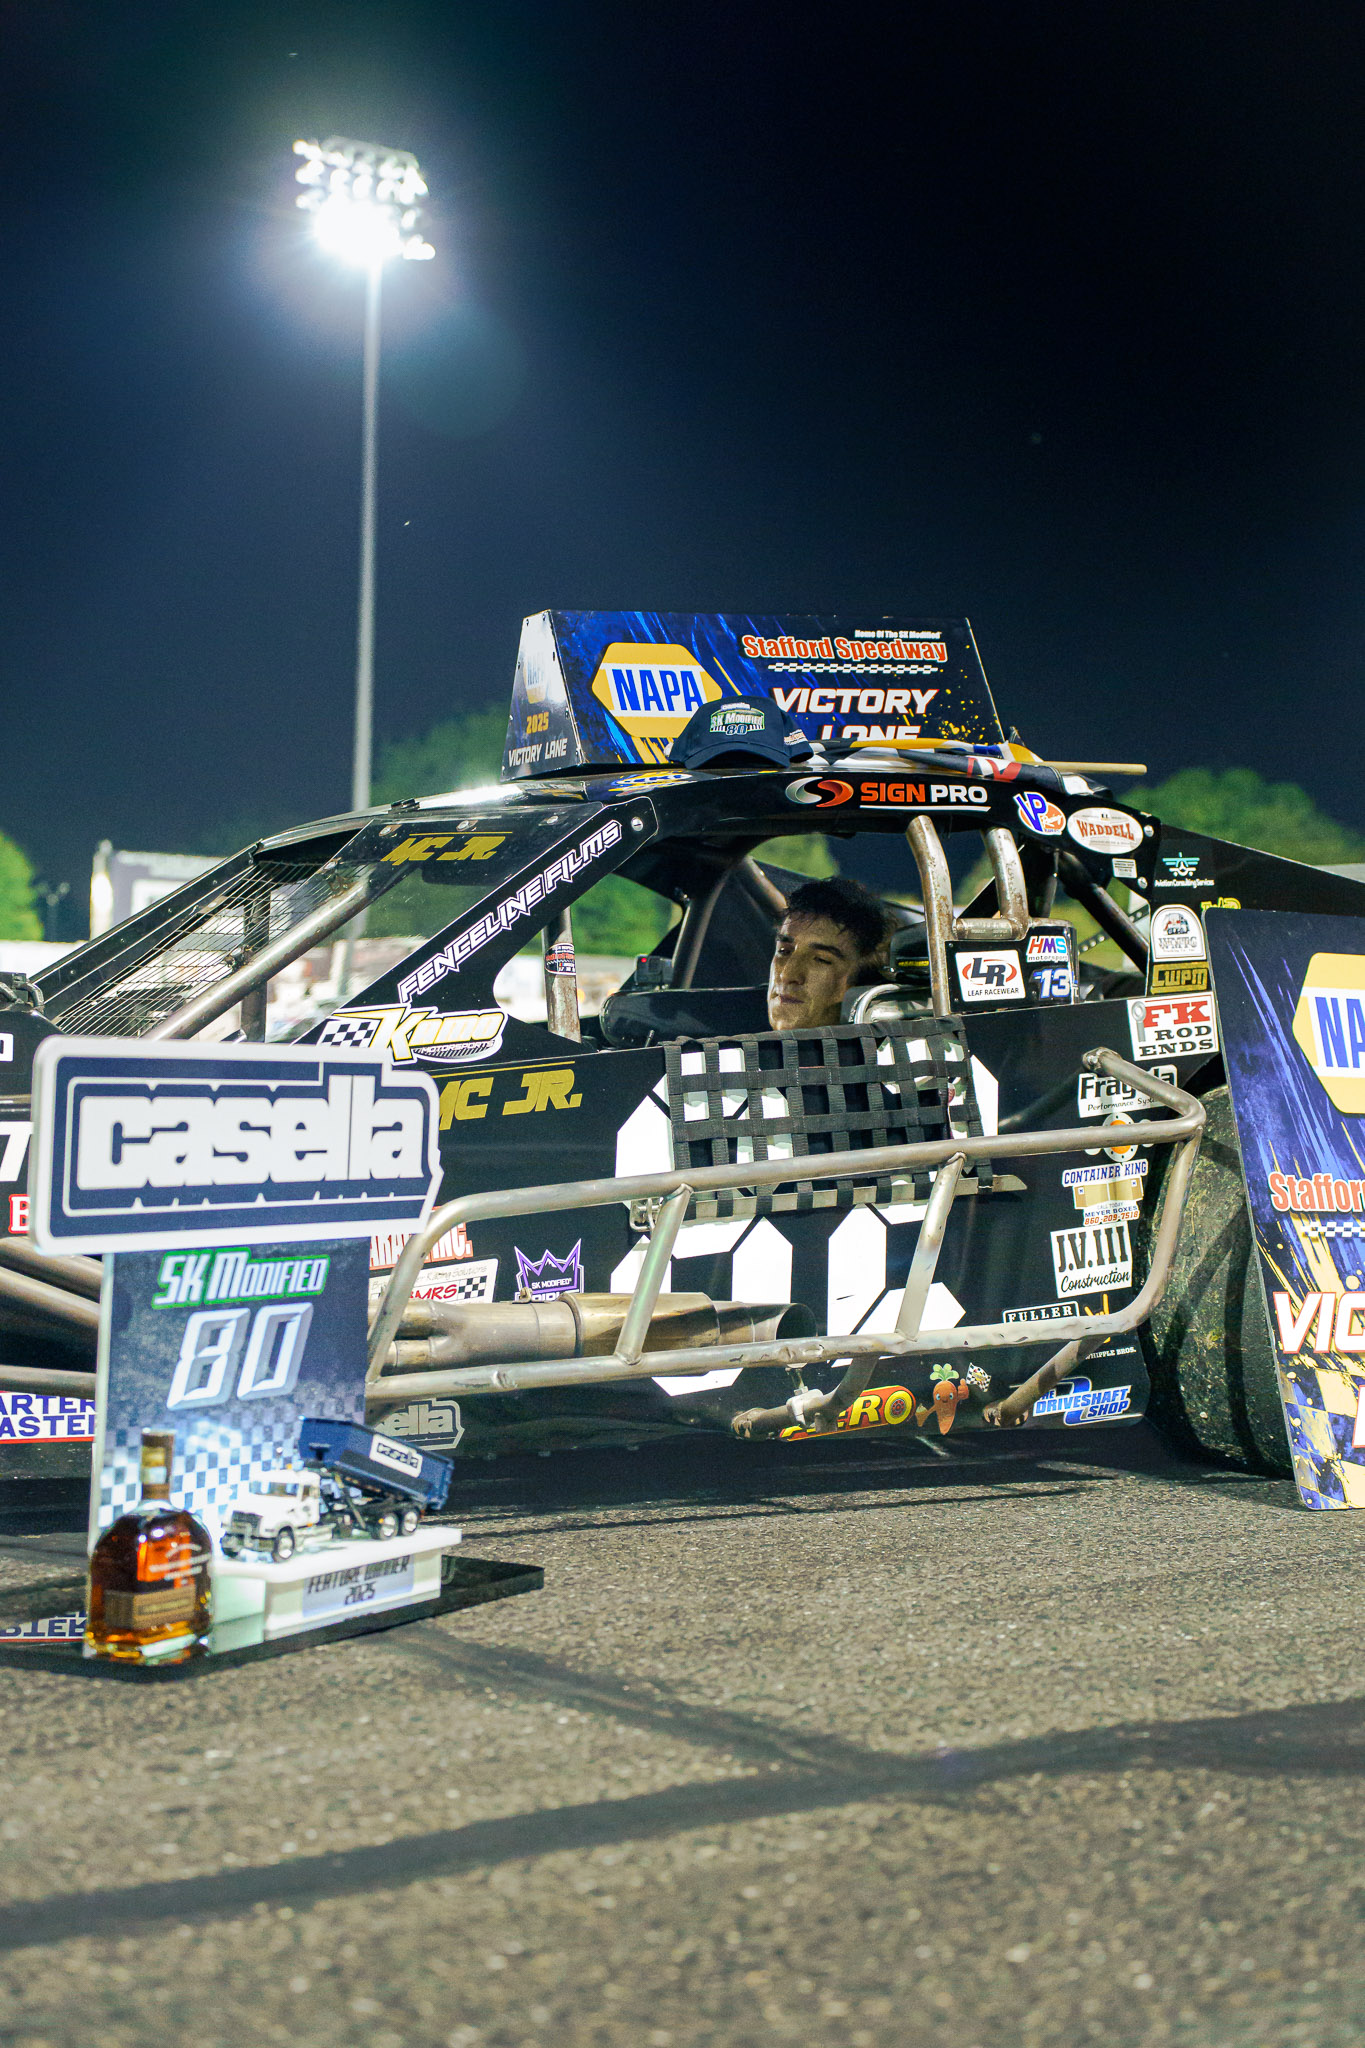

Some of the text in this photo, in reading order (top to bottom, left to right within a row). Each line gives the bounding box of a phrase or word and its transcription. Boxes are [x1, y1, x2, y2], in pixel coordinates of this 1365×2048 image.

[742, 634, 949, 663] Stafford Speedway
[612, 668, 707, 712] NAPA
[773, 688, 939, 714] VICTORY
[526, 711, 549, 734] 2025
[726, 723, 748, 735] 80
[508, 738, 568, 767] VICTORY LANE
[860, 782, 988, 803] SIGN PRO
[1015, 793, 1047, 832] VP
[1076, 819, 1135, 841] WADDELL
[398, 819, 622, 1004] FENCELINE FILMS
[1028, 937, 1067, 954] HMS
[970, 957, 1006, 987] LR
[1040, 968, 1071, 998] 13
[985, 987, 1019, 996] RACEWEAR
[1144, 1001, 1210, 1028] FK
[1155, 1025, 1212, 1041] ROD
[422, 1039, 496, 1053] MOTORSPORTS
[1139, 1038, 1213, 1057] ENDS
[502, 1069, 583, 1116] JR.
[1081, 1067, 1174, 1100] Fraga
[1087, 1100, 1134, 1111] Performance
[77, 1074, 425, 1191] casella
[1064, 1161, 1147, 1184] CONTAINER KING
[1269, 1171, 1365, 1213] Staffor
[1085, 1205, 1138, 1217] MEYER BOXES
[153, 1253, 210, 1305] SK
[531, 1281, 541, 1290] SK
[1061, 1267, 1131, 1293] Construction
[1008, 1305, 1073, 1322] FULLER
[167, 1302, 314, 1411] 80
[1116, 1346, 1137, 1356] BROS.
[1035, 1388, 1130, 1414] DRIVESHAFT
[1087, 1400, 1130, 1418] SHOP
[344, 1581, 376, 1605] 2025
